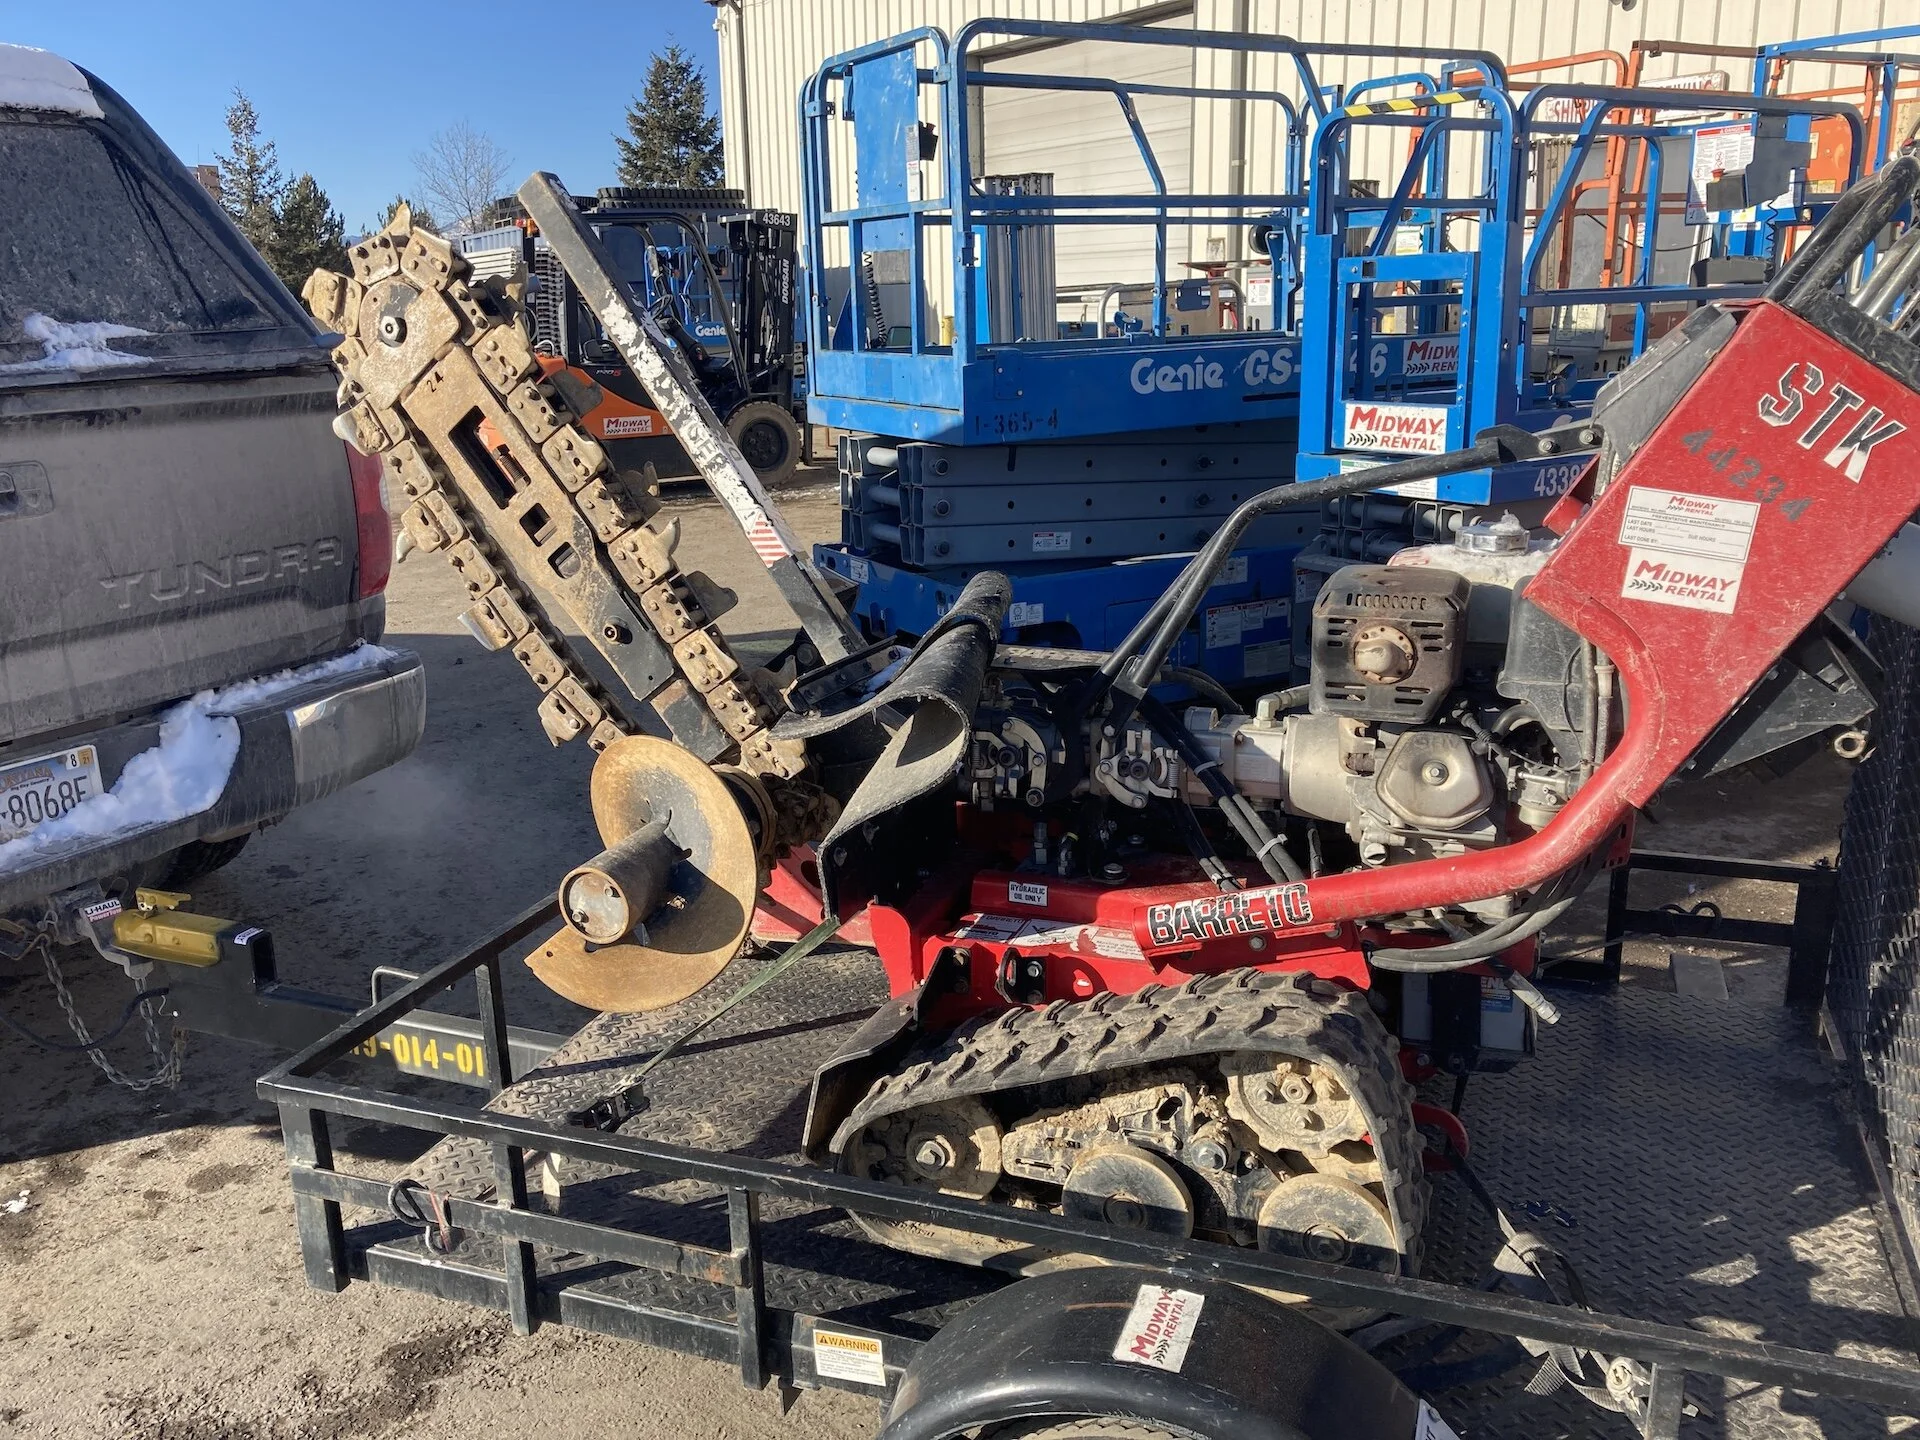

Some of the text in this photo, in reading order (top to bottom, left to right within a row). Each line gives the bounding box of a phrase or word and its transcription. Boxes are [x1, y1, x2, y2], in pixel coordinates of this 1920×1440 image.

[762, 212, 791, 226] 43643
[782, 258, 790, 304] DOOSAN
[1407, 340, 1459, 361] MIDW
[1130, 354, 1225, 395] Genie
[1432, 361, 1459, 372] REN
[606, 419, 650, 429] MIDWAY
[1350, 406, 1444, 435] MIDWAY
[1758, 361, 1908, 484] STK
[1380, 435, 1438, 451] RENTAL
[1533, 464, 1588, 497] 4338
[1681, 428, 1815, 522] 44234
[1668, 496, 1718, 510] MIDWAY
[1684, 508, 1714, 516] RENTAL
[100, 535, 344, 609] TUNDRA
[1633, 559, 1738, 592] MIDWAY
[1664, 585, 1726, 603] RENTAL
[70, 753, 77, 767] 8
[1010, 883, 1046, 895] HYDRAULIC
[1025, 894, 1042, 903] ONLY
[86, 900, 121, 915] U-HAUL
[1146, 883, 1313, 946] BARRETO
[1130, 1291, 1174, 1360] MIDWAY
[1163, 1298, 1187, 1339] RENTAL
[828, 1336, 878, 1353] WARNING
